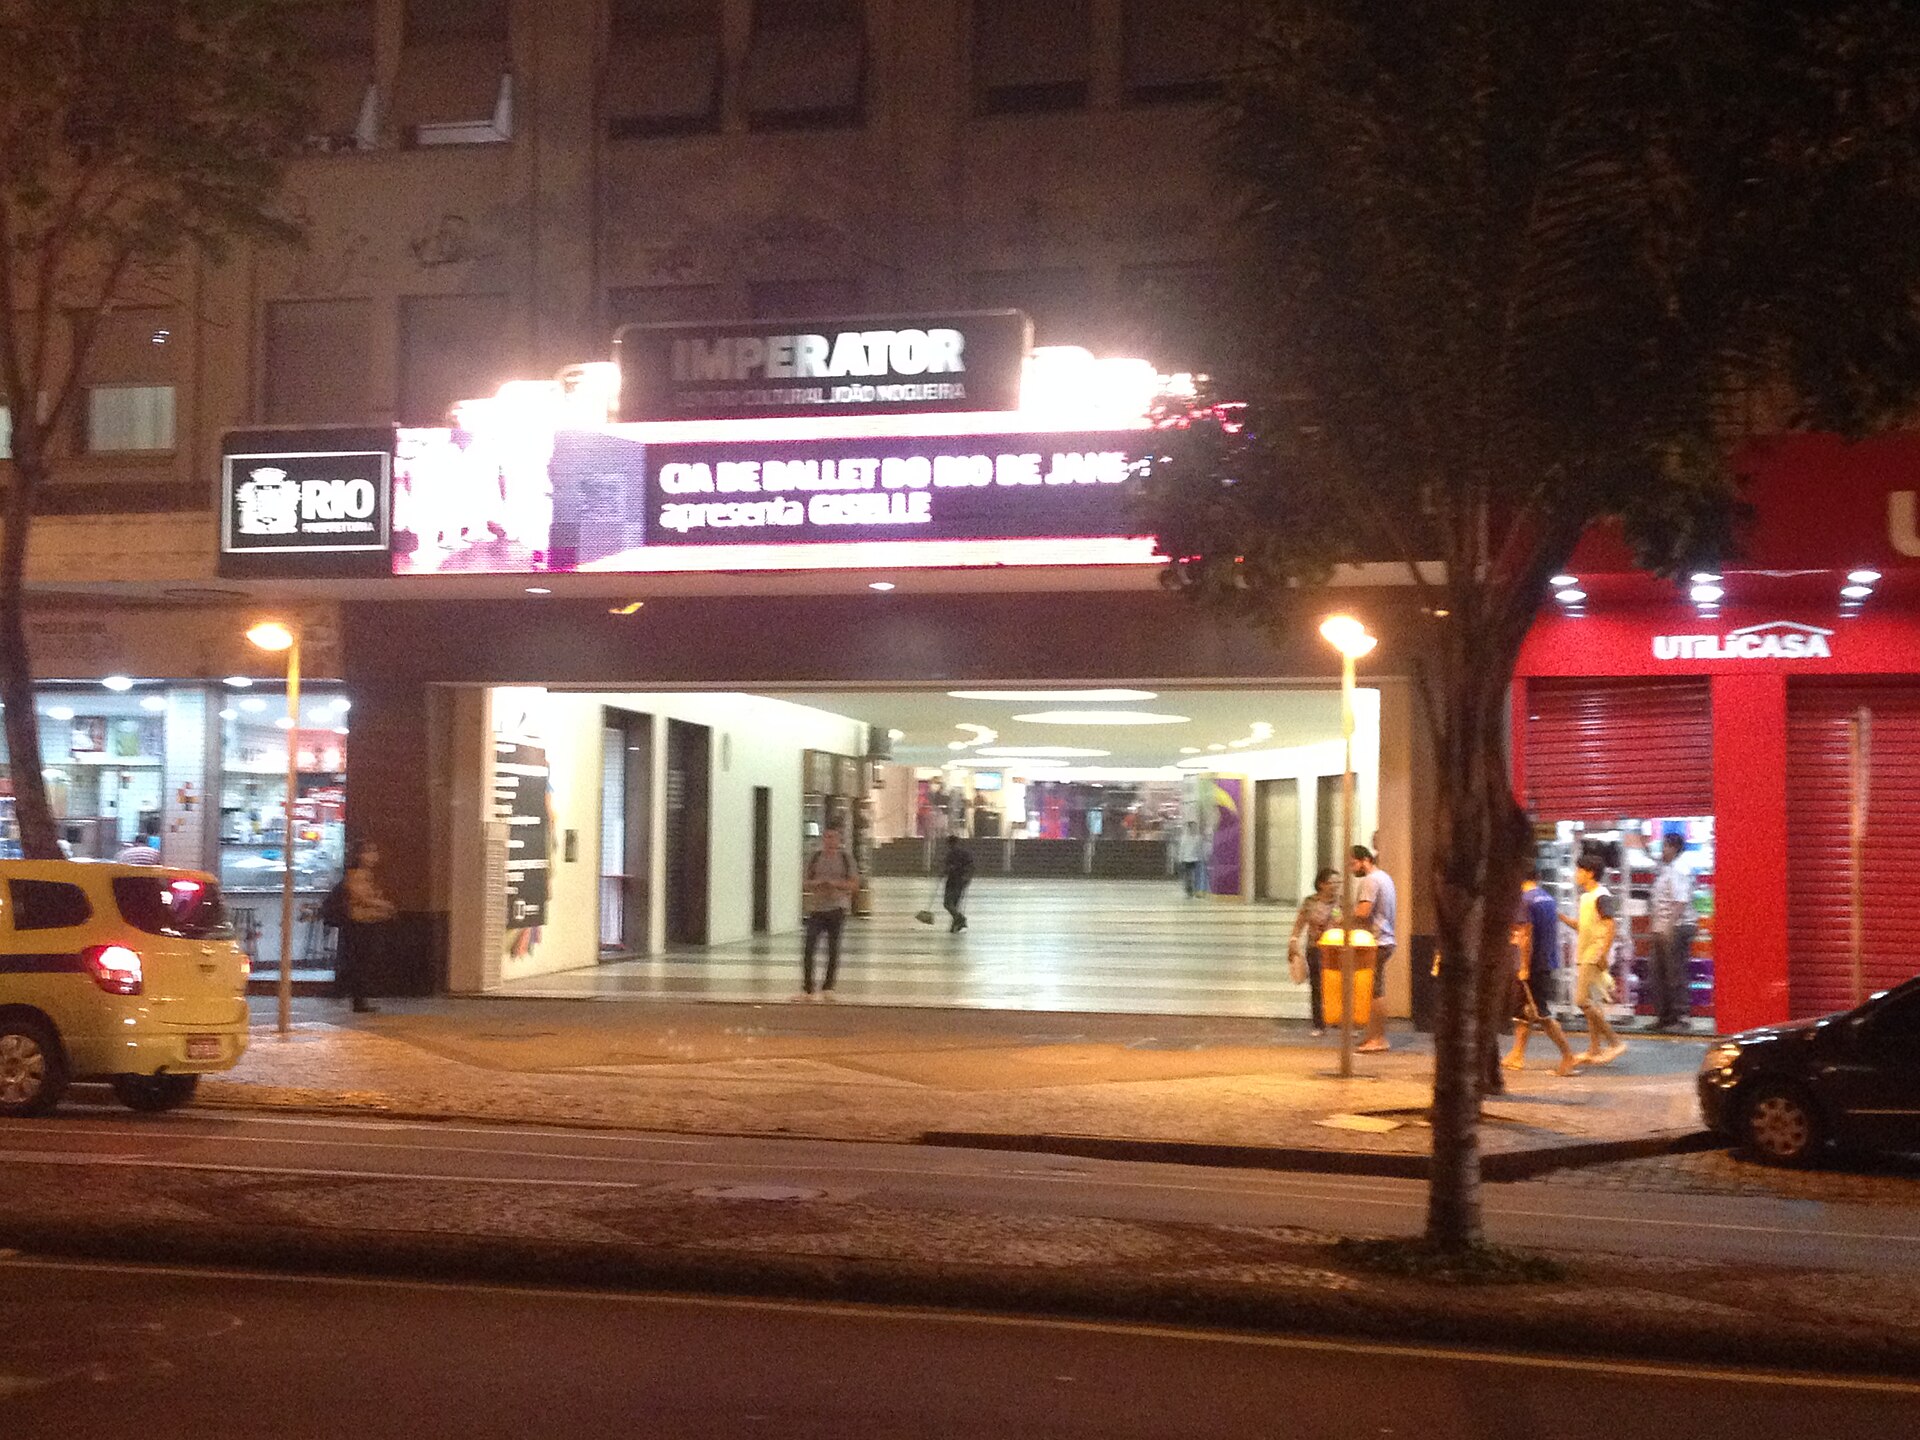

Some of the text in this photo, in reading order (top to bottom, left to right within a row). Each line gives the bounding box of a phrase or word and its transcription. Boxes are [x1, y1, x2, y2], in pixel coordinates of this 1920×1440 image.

[672, 329, 966, 380] IMPERATOR
[301, 479, 376, 520] RIO
[659, 496, 804, 533] apresenta
